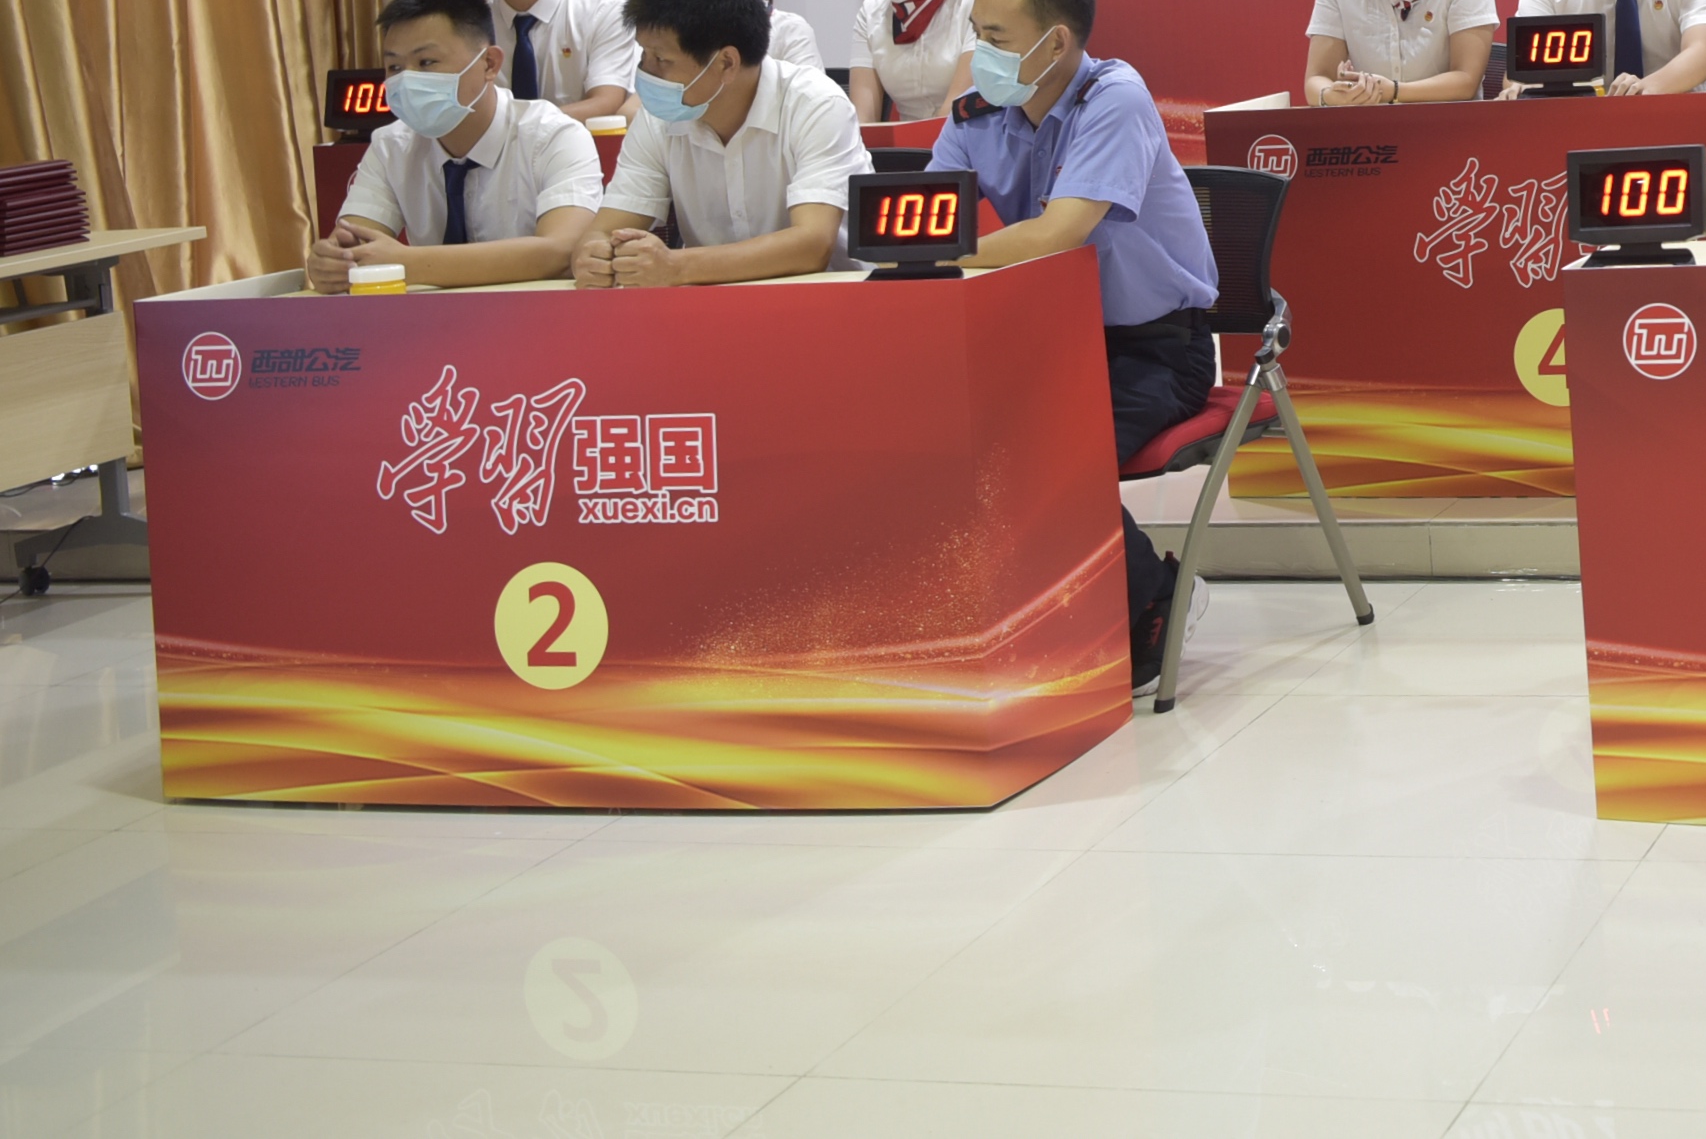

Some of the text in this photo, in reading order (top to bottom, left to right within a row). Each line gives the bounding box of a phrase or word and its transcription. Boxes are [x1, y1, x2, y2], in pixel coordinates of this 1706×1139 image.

[1530, 30, 1592, 64] 100
[1306, 145, 1399, 166] 西部公汽
[1357, 167, 1381, 176] BUS
[1600, 169, 1687, 217] 100
[876, 193, 957, 237] 100
[251, 347, 361, 374] 西部公汽
[311, 375, 340, 386] BUS
[579, 492, 718, 524] xuexi.cn
[526, 580, 577, 667] 2
